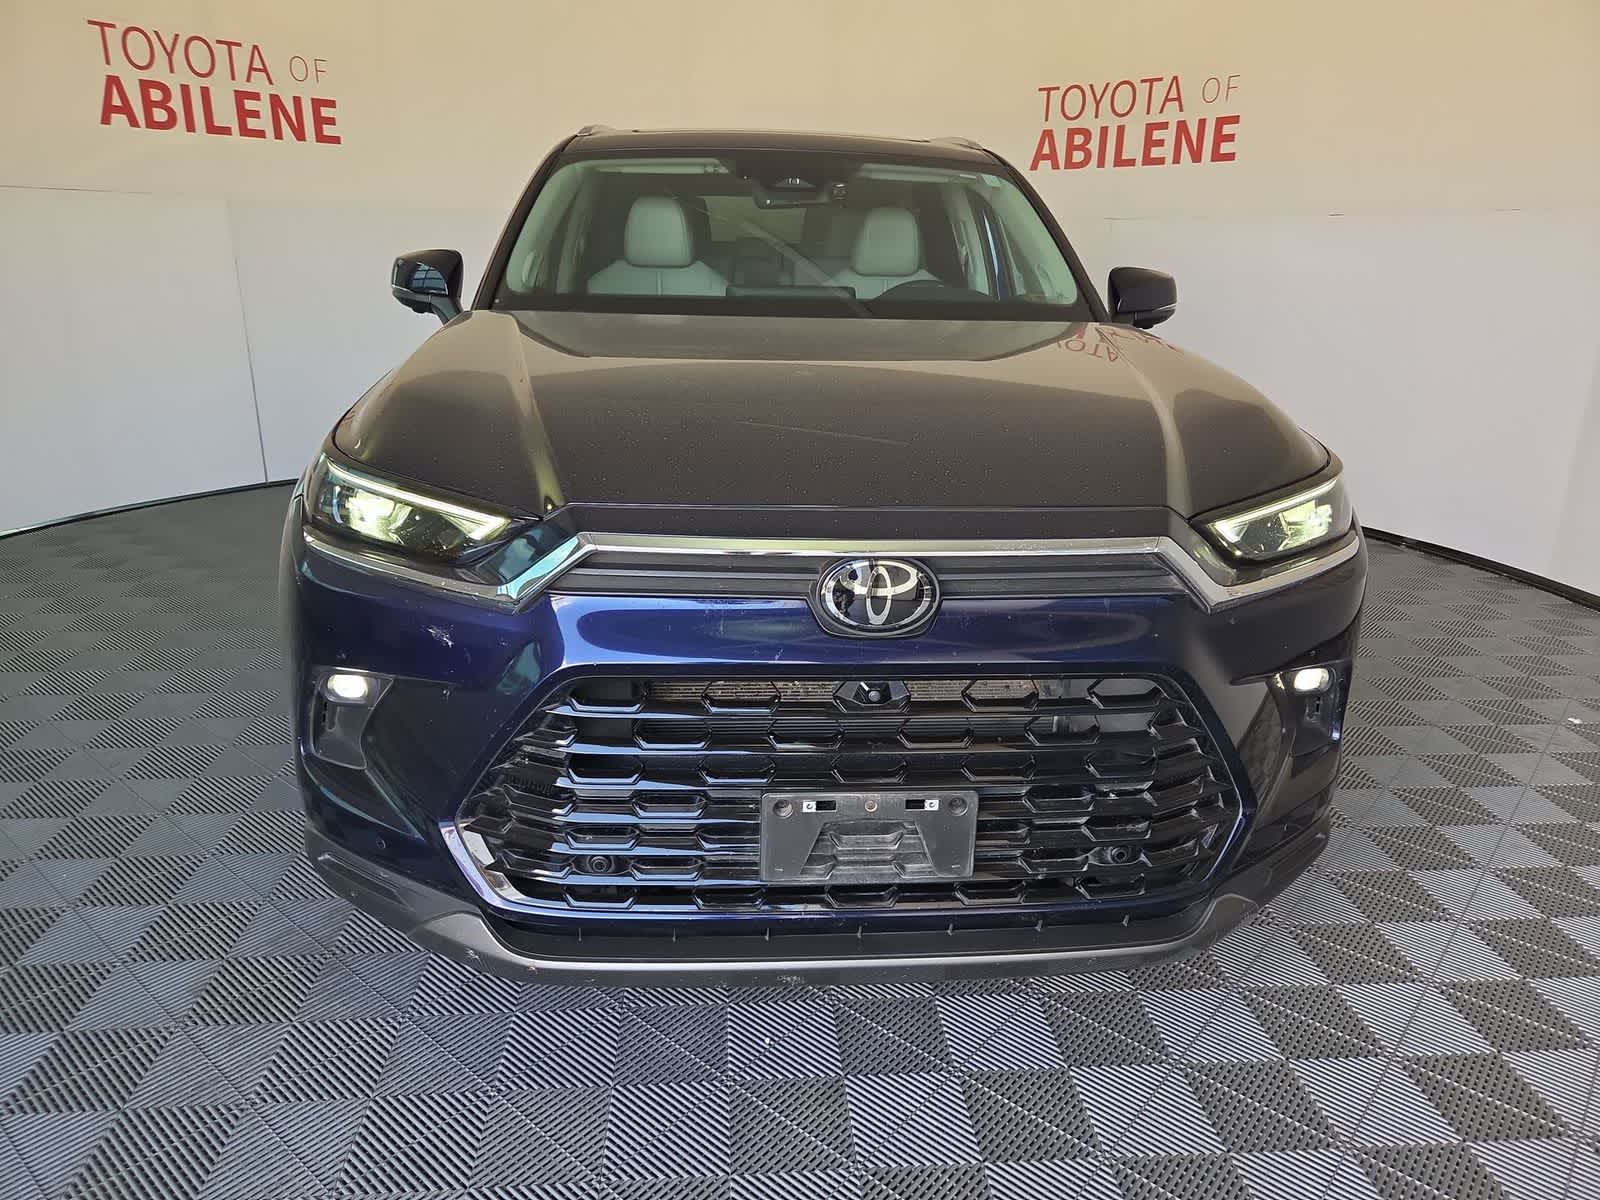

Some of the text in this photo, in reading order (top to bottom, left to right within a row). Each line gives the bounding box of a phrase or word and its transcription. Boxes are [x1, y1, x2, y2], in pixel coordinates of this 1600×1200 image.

[87, 19, 327, 86] TOYOTA OF
[100, 73, 342, 145] ABILENE
[1038, 74, 1241, 122] TOYOTA OF
[1029, 114, 1242, 172] ABILENE
